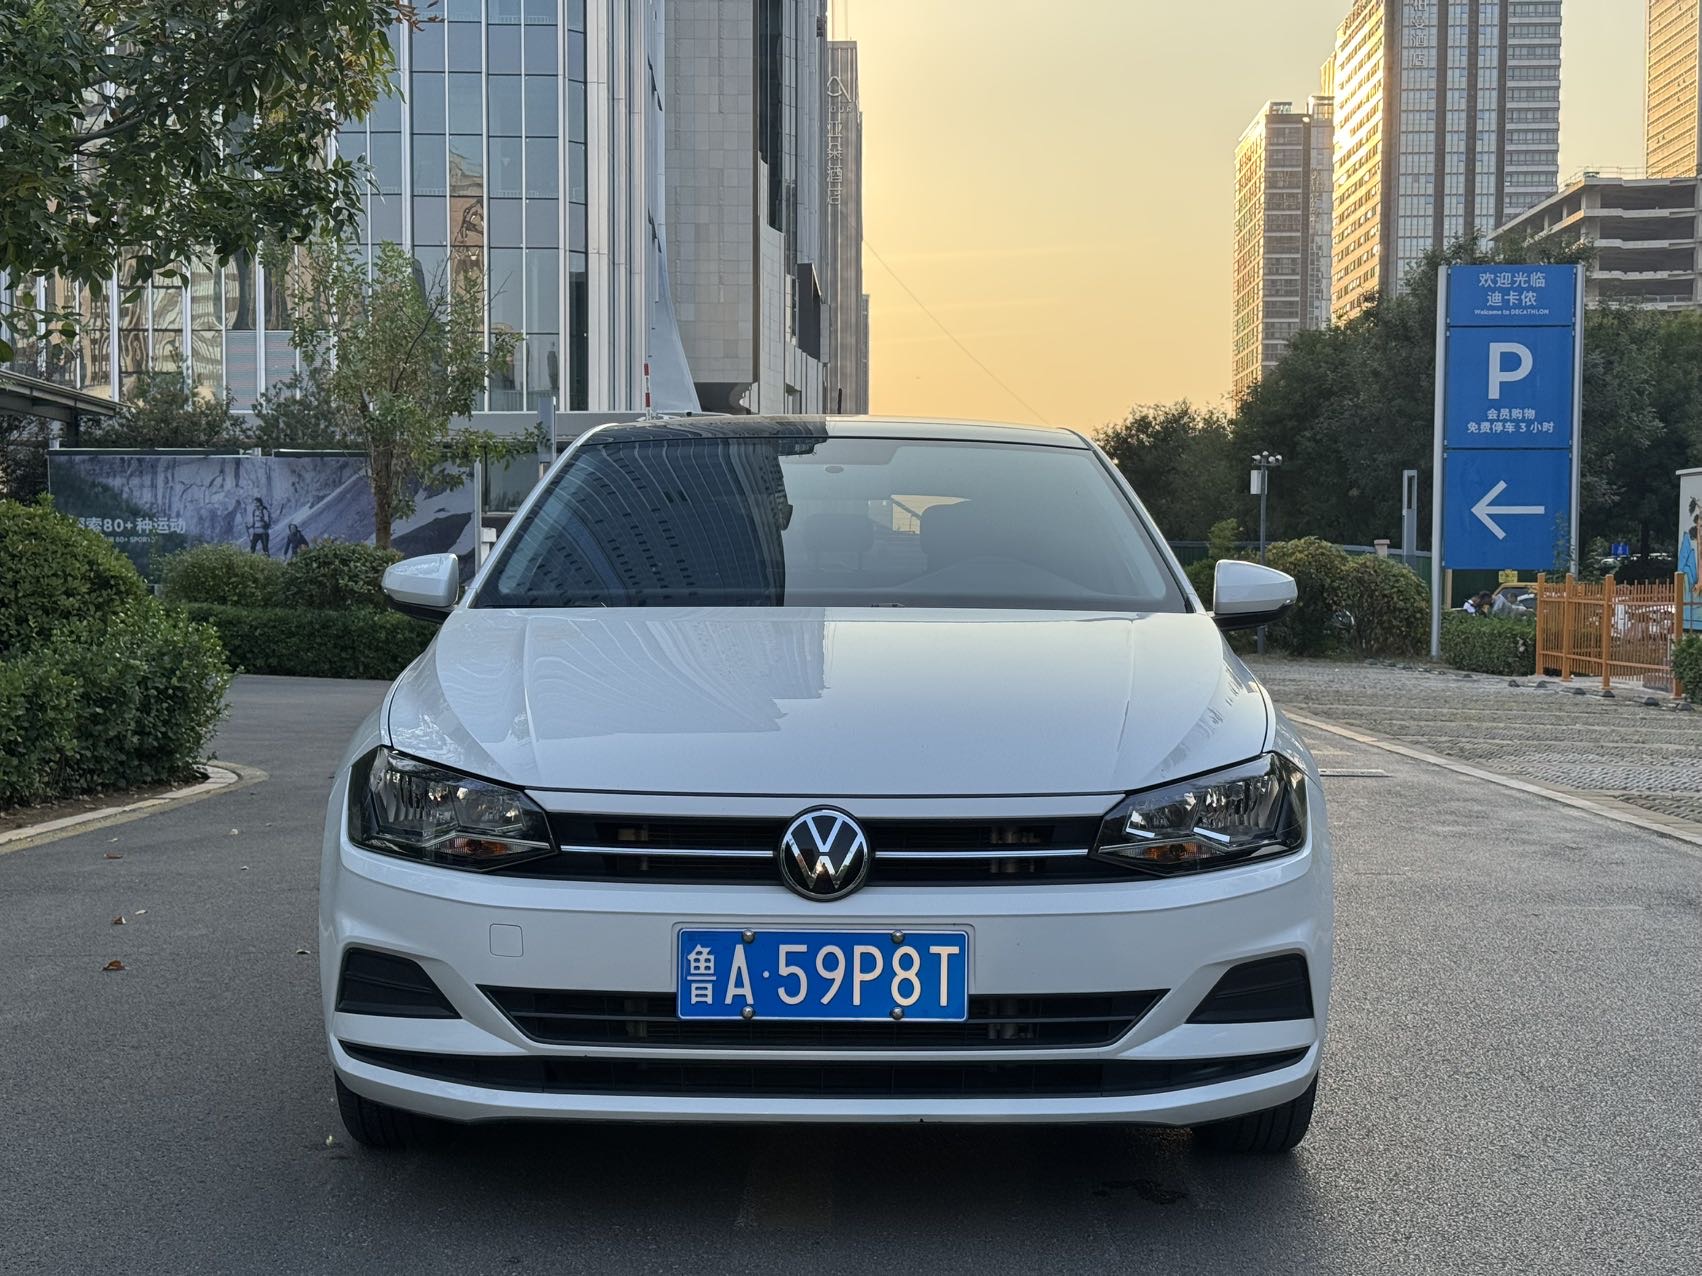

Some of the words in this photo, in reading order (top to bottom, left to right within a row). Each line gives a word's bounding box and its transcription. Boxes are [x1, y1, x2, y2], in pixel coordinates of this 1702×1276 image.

[826, 120, 843, 205] 亚朵酒店
[1478, 271, 1546, 288] 欢迎光临
[1486, 290, 1537, 306] 迪卡侬
[1488, 342, 1533, 400] P
[1487, 408, 1536, 420] 会员购物
